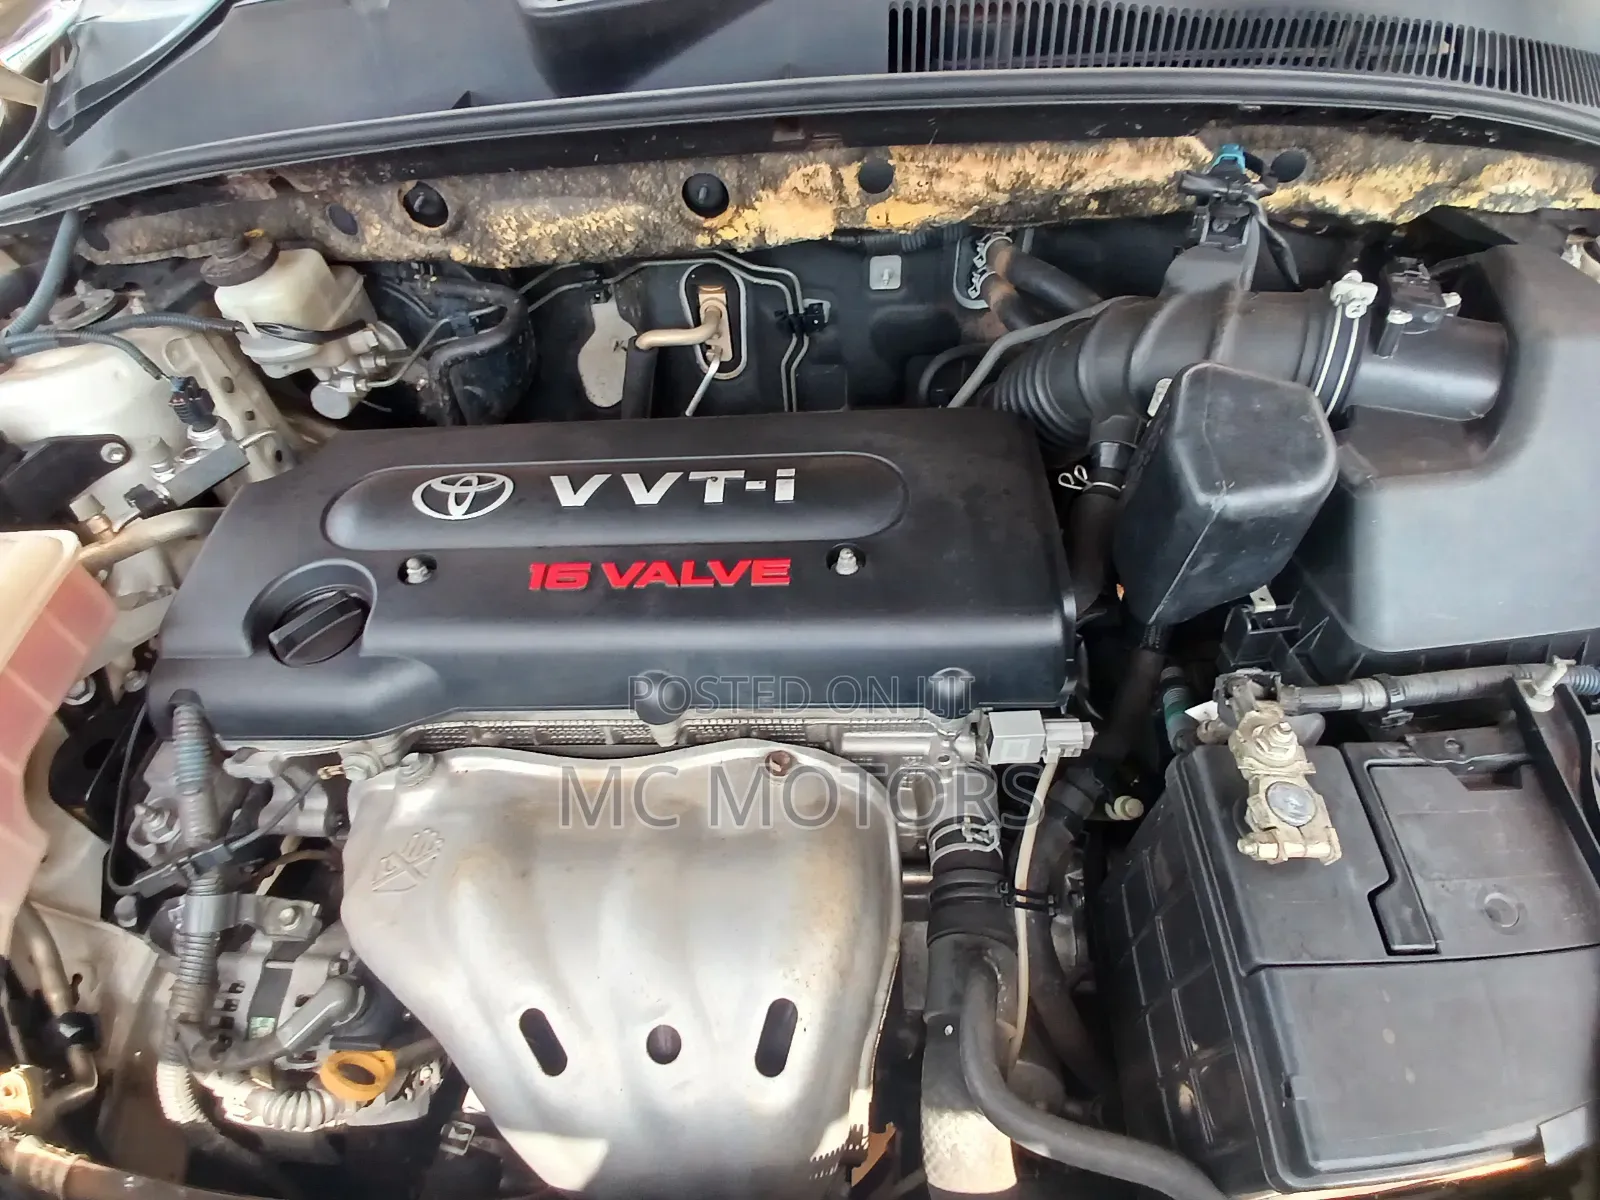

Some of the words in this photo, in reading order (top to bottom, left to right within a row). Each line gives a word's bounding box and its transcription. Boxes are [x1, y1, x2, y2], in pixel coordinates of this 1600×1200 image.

[549, 467, 796, 508] VVT-i
[528, 561, 592, 591] 16
[601, 557, 792, 590] VALVE
